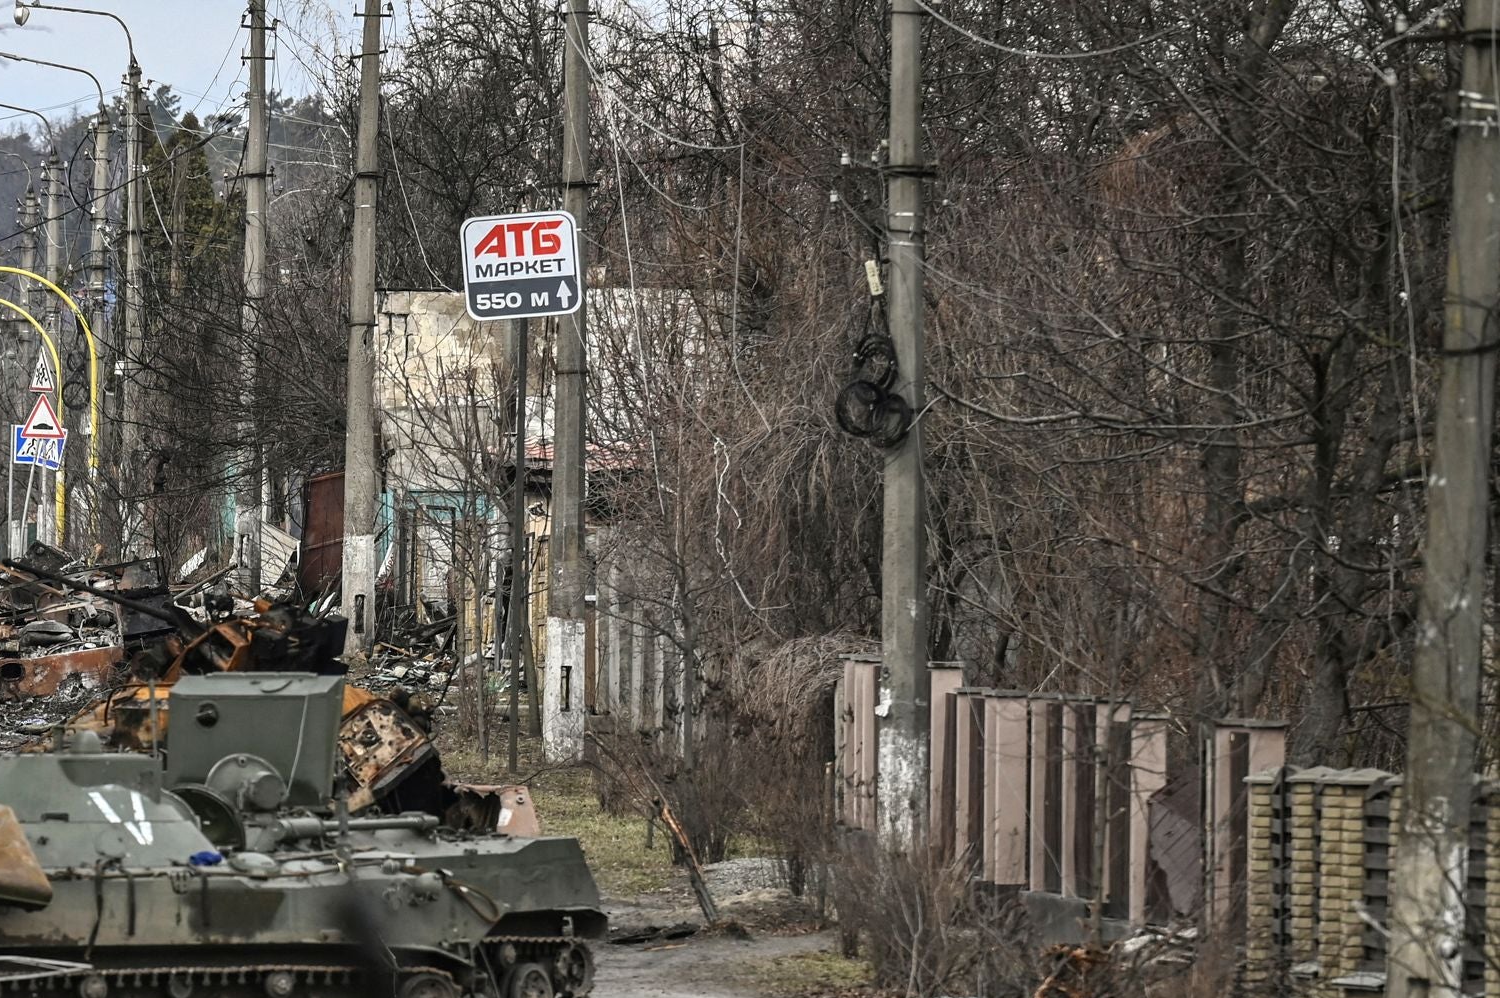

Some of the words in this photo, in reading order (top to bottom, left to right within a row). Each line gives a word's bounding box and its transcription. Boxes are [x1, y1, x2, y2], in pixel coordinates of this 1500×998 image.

[474, 220, 564, 259] АТБ
[475, 258, 566, 279] МАРКЕТ
[476, 293, 522, 310] 550
[88, 791, 154, 845] V
